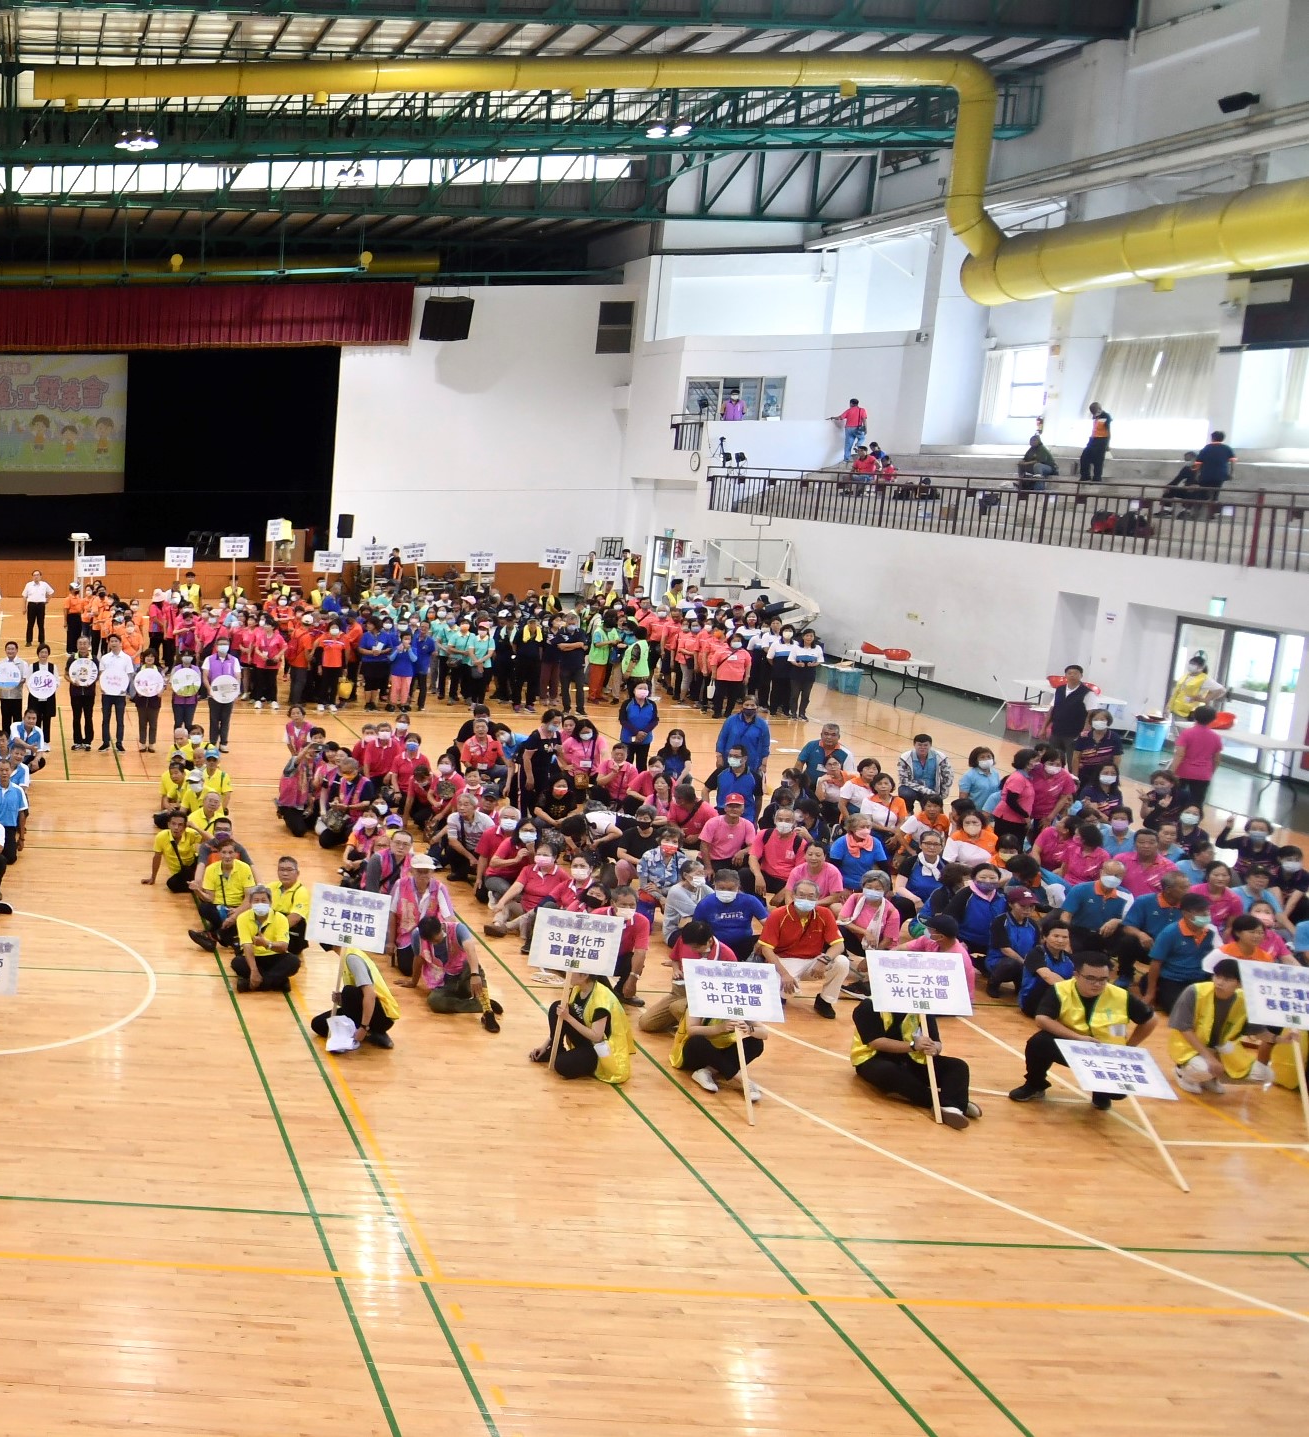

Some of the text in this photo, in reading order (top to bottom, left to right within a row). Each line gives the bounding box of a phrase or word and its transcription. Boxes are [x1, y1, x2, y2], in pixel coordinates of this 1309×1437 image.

[323, 907, 374, 924] 32. 員林市
[548, 932, 605, 948] 33. 彰化市
[885, 974, 949, 986] 35. 二水鄉
[701, 982, 763, 994] 34. 花壇鄉
[891, 986, 949, 999] 光化社區
[707, 994, 761, 1006] 中口社區
[1103, 1061, 1146, 1074] 二水鄉
